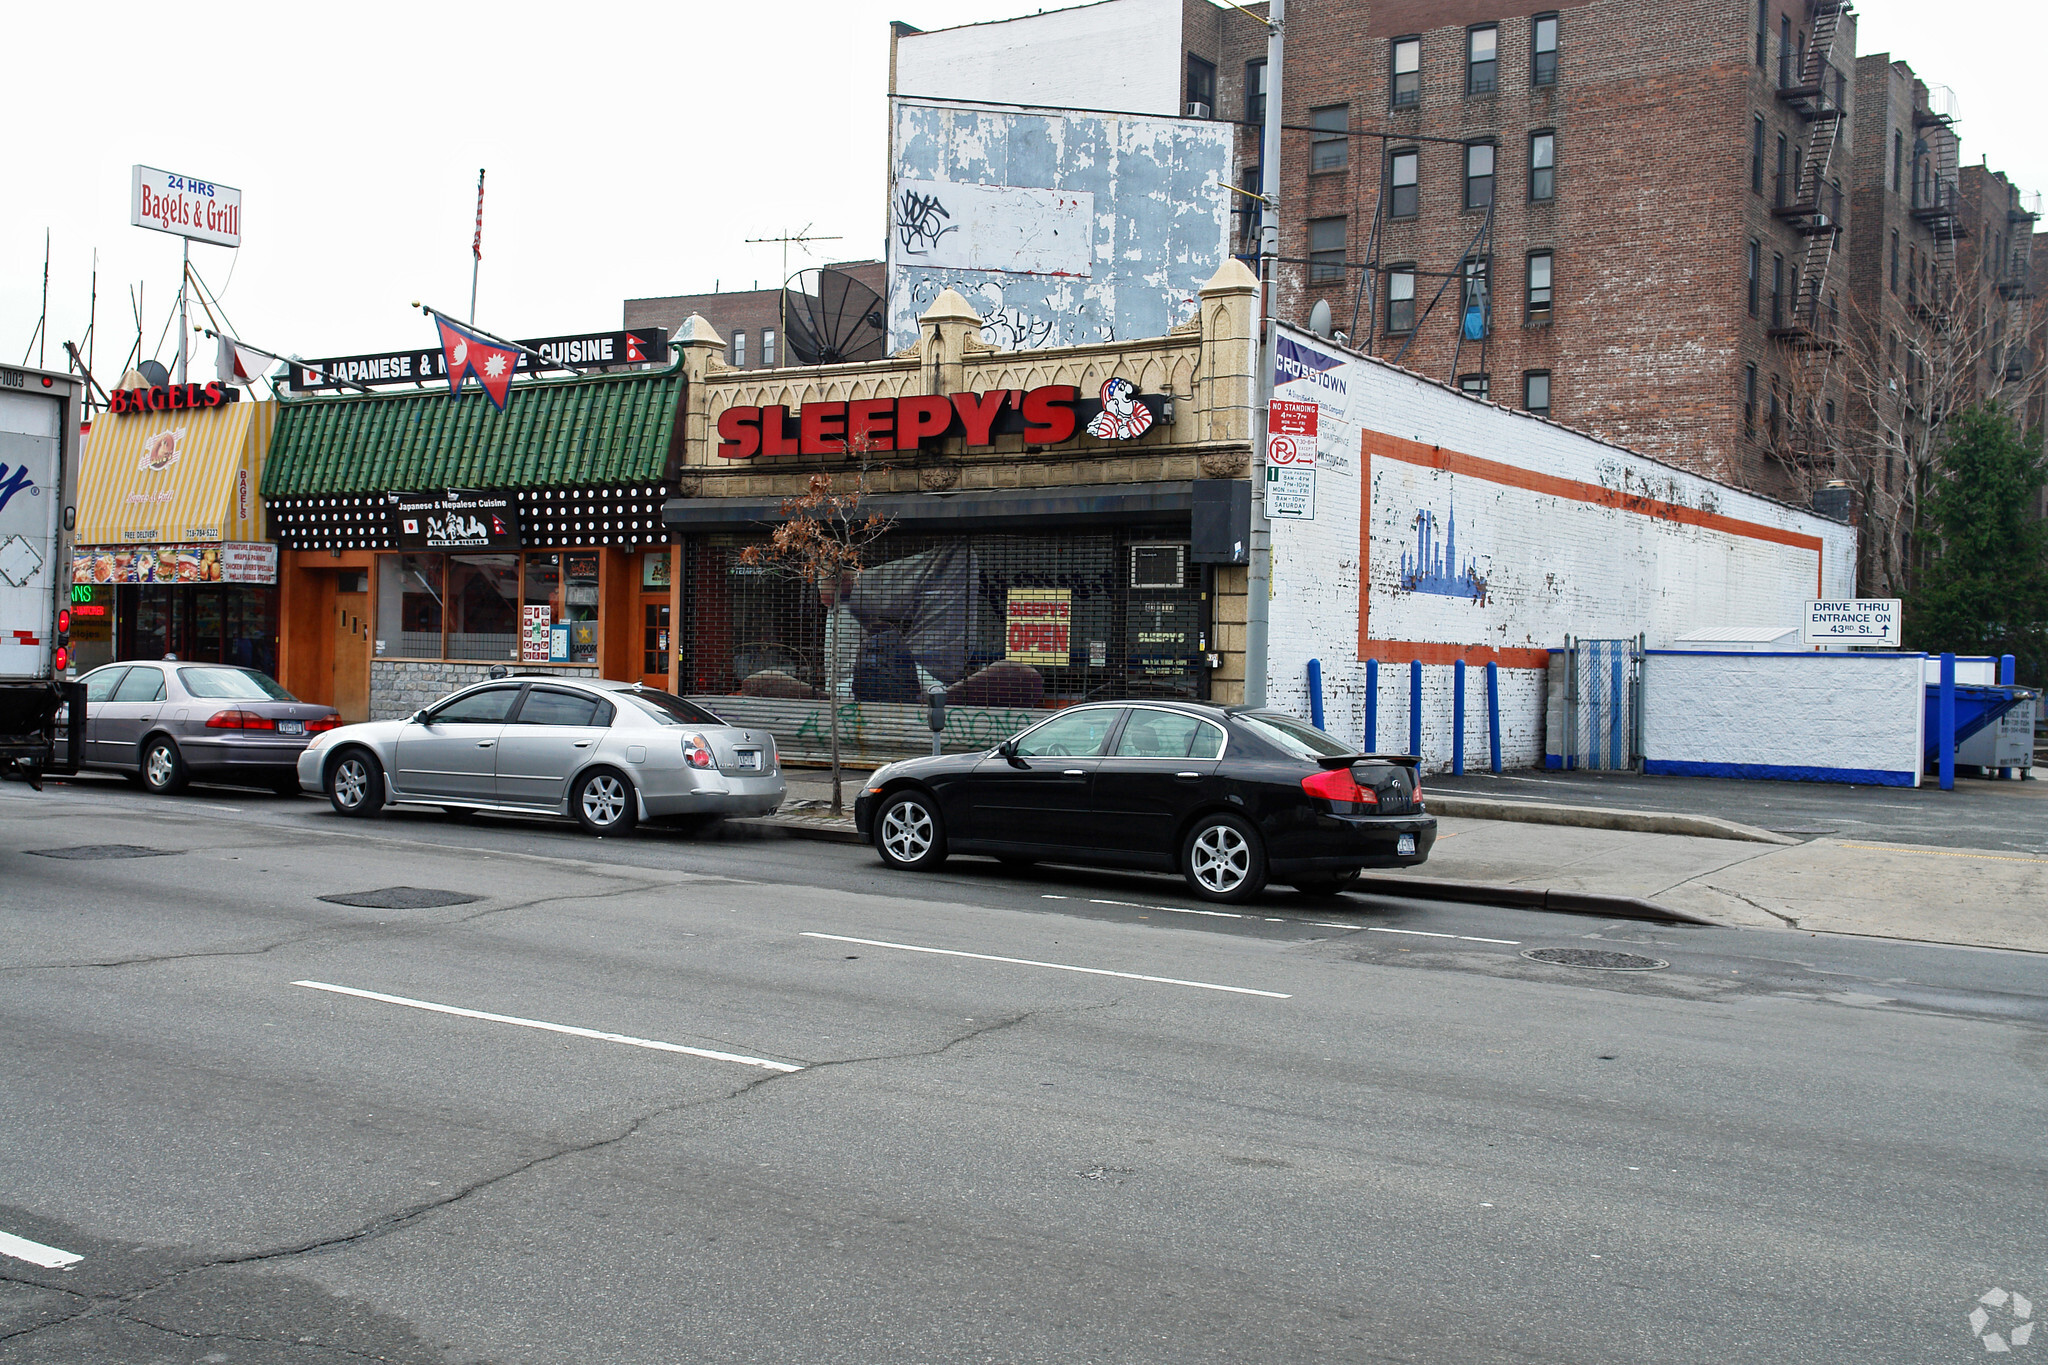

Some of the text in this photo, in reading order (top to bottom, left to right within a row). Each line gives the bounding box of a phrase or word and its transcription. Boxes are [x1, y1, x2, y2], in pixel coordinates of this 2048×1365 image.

[168, 175, 214, 198] 24 HRS
[142, 184, 238, 235] Bagels & Grill
[538, 339, 614, 365] CUISINE
[330, 357, 411, 384] JAPANESE
[420, 355, 431, 375] &
[1276, 353, 1347, 396] CROSSTOWN
[110, 381, 222, 414] BAGELS
[1272, 402, 1316, 413] NO STANDING
[717, 384, 1078, 459] SLEEPY'S
[1271, 468, 1275, 481] 1
[239, 470, 247, 519] BAGELS
[399, 498, 507, 512] Japanese & Nepalese Cuisine
[1274, 501, 1306, 509] SATURDAY
[125, 530, 158, 539] FREE DELIVERY
[249, 545, 273, 553] SANDWICHES
[1009, 601, 1069, 618] SLEEPY'S
[1814, 602, 1889, 612] DRIVE THRU
[1812, 614, 1890, 623] ENTRANCE ON
[1858, 624, 1872, 634] St.
[1009, 622, 1069, 652] OPEN
[1138, 632, 1185, 643] SLEEPY'S
[2023, 753, 2029, 765] 2
